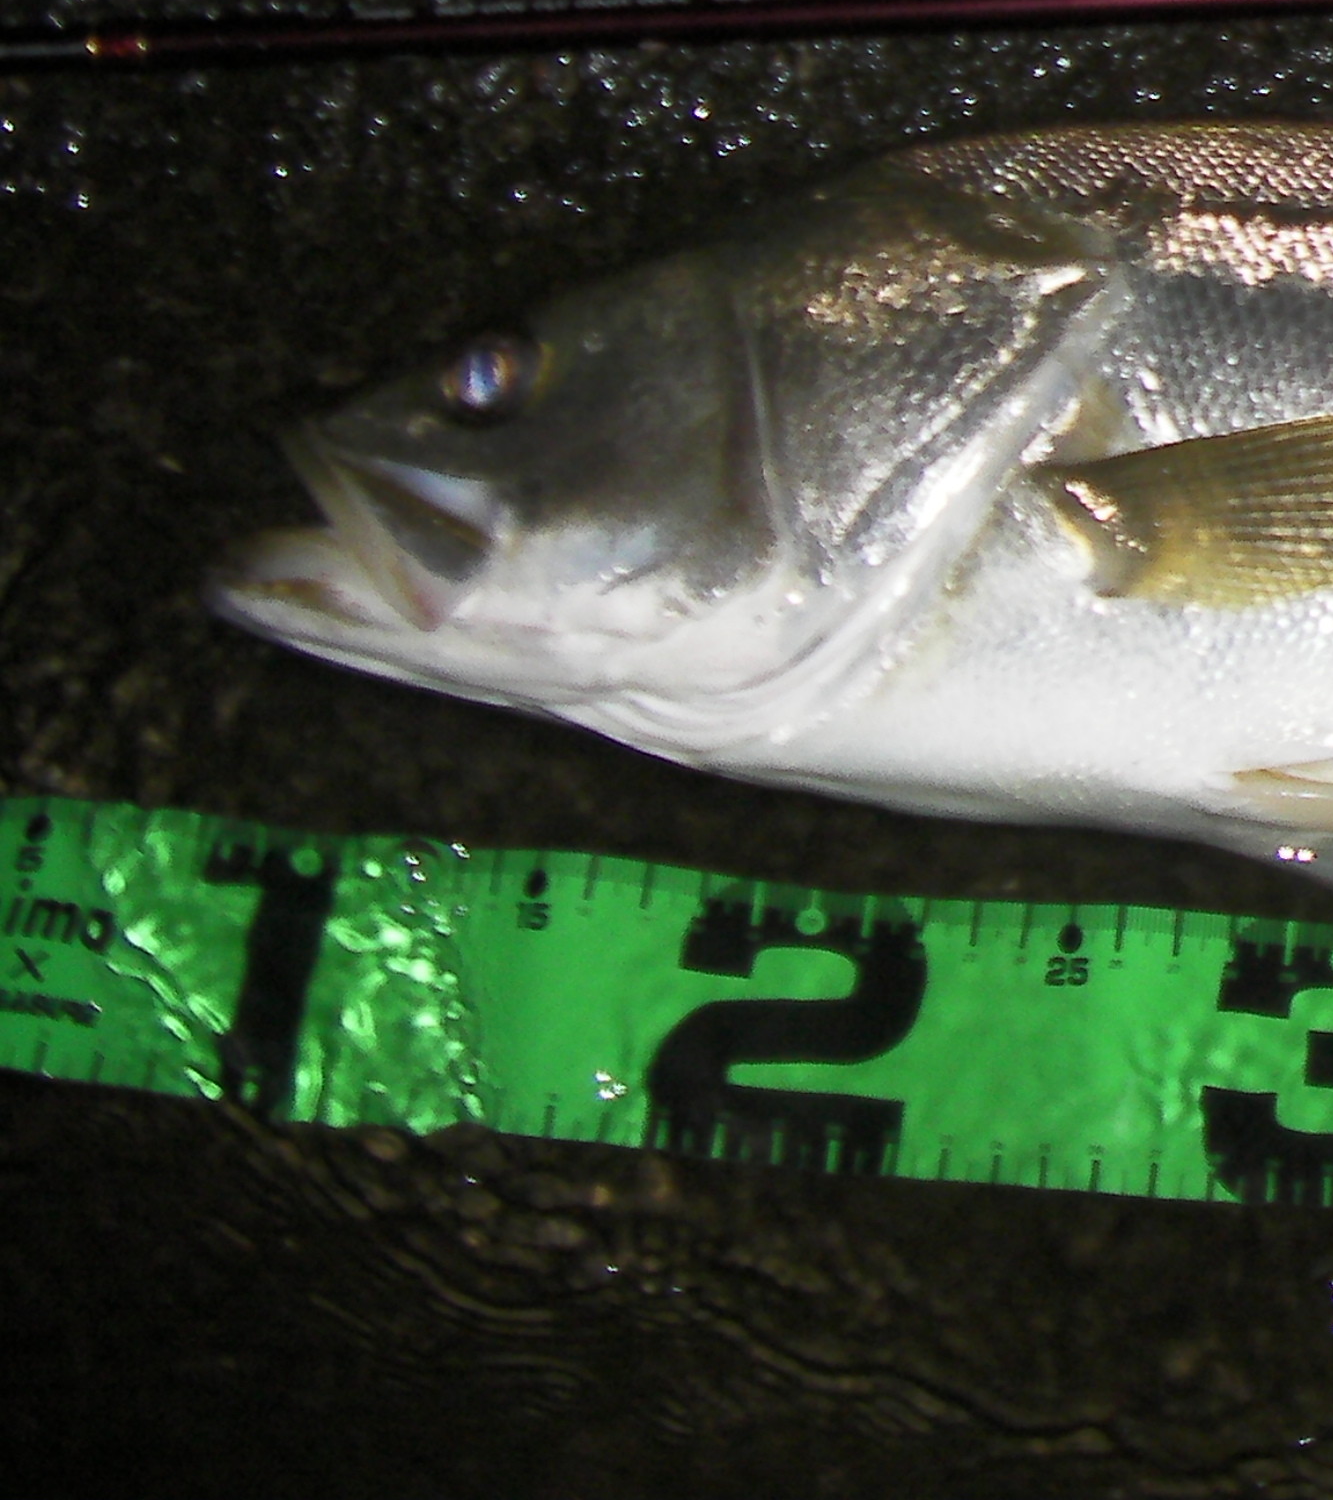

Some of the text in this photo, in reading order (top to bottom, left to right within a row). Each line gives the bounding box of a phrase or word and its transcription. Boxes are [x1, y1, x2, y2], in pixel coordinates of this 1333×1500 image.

[202, 830, 338, 1112] 1
[647, 884, 926, 1174] 2
[1045, 956, 1089, 987] 25
